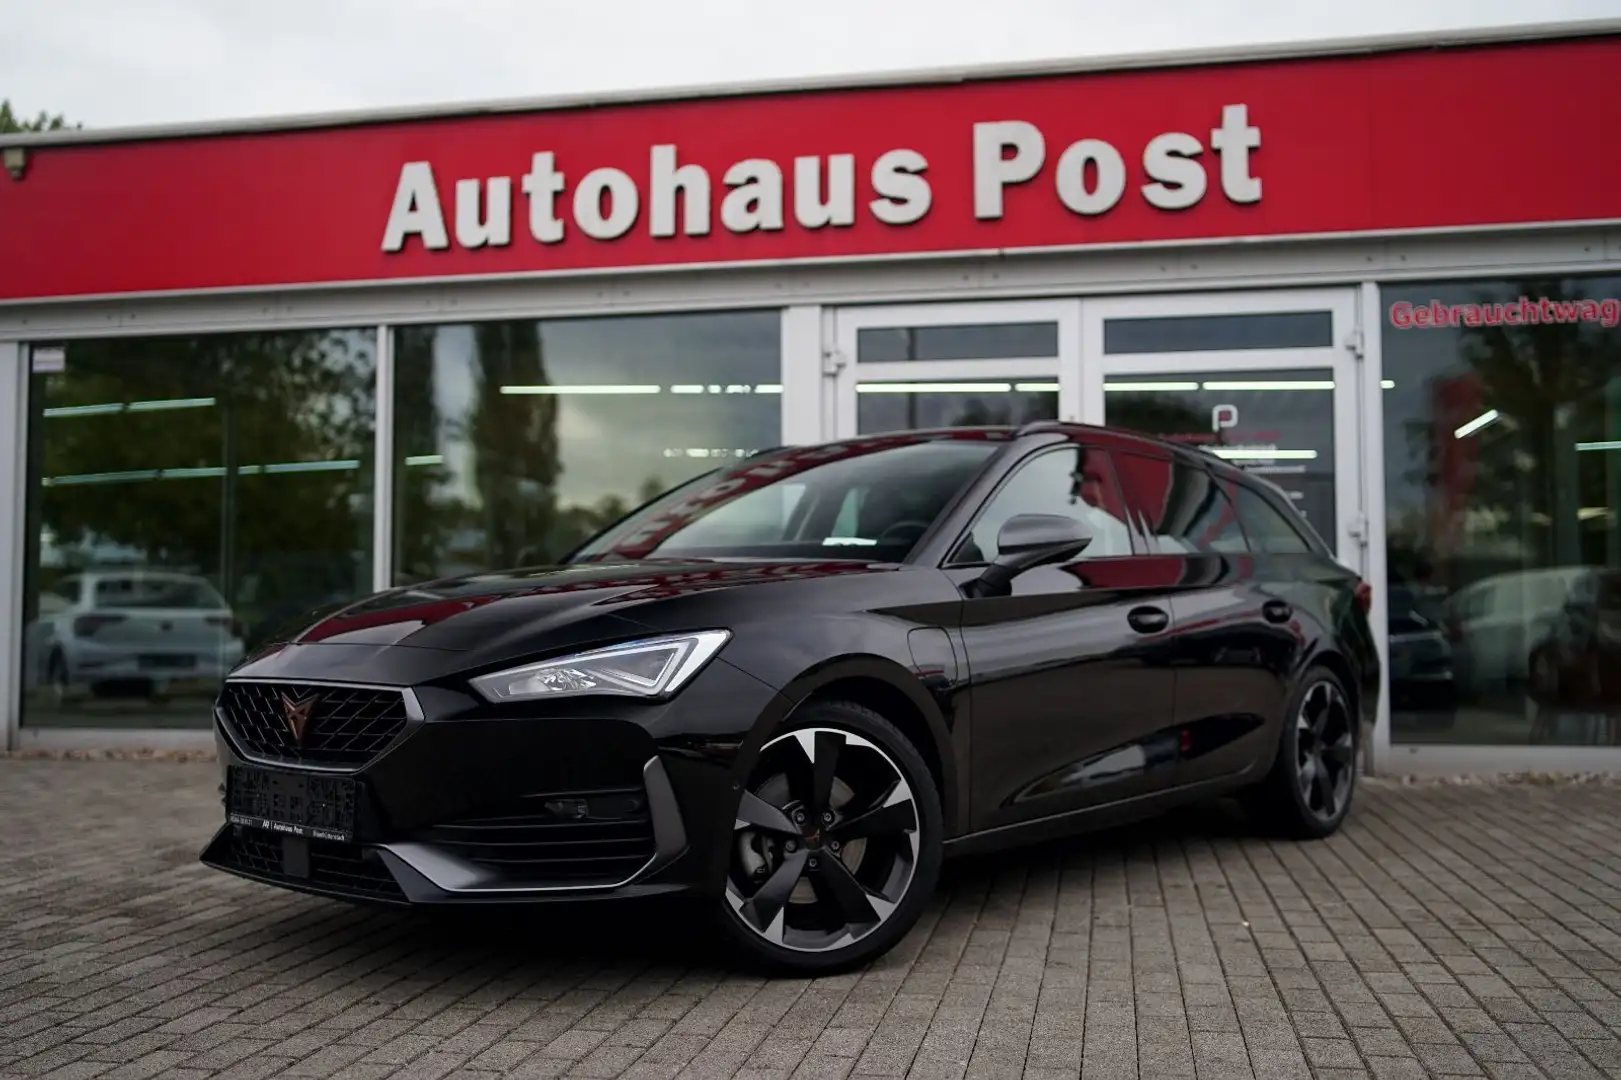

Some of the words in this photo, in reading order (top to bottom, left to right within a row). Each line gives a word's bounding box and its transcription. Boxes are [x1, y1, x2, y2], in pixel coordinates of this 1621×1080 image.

[381, 144, 933, 251] Autohaus
[973, 103, 1263, 219] Post
[1389, 297, 1620, 330] Gebrauchtwag
